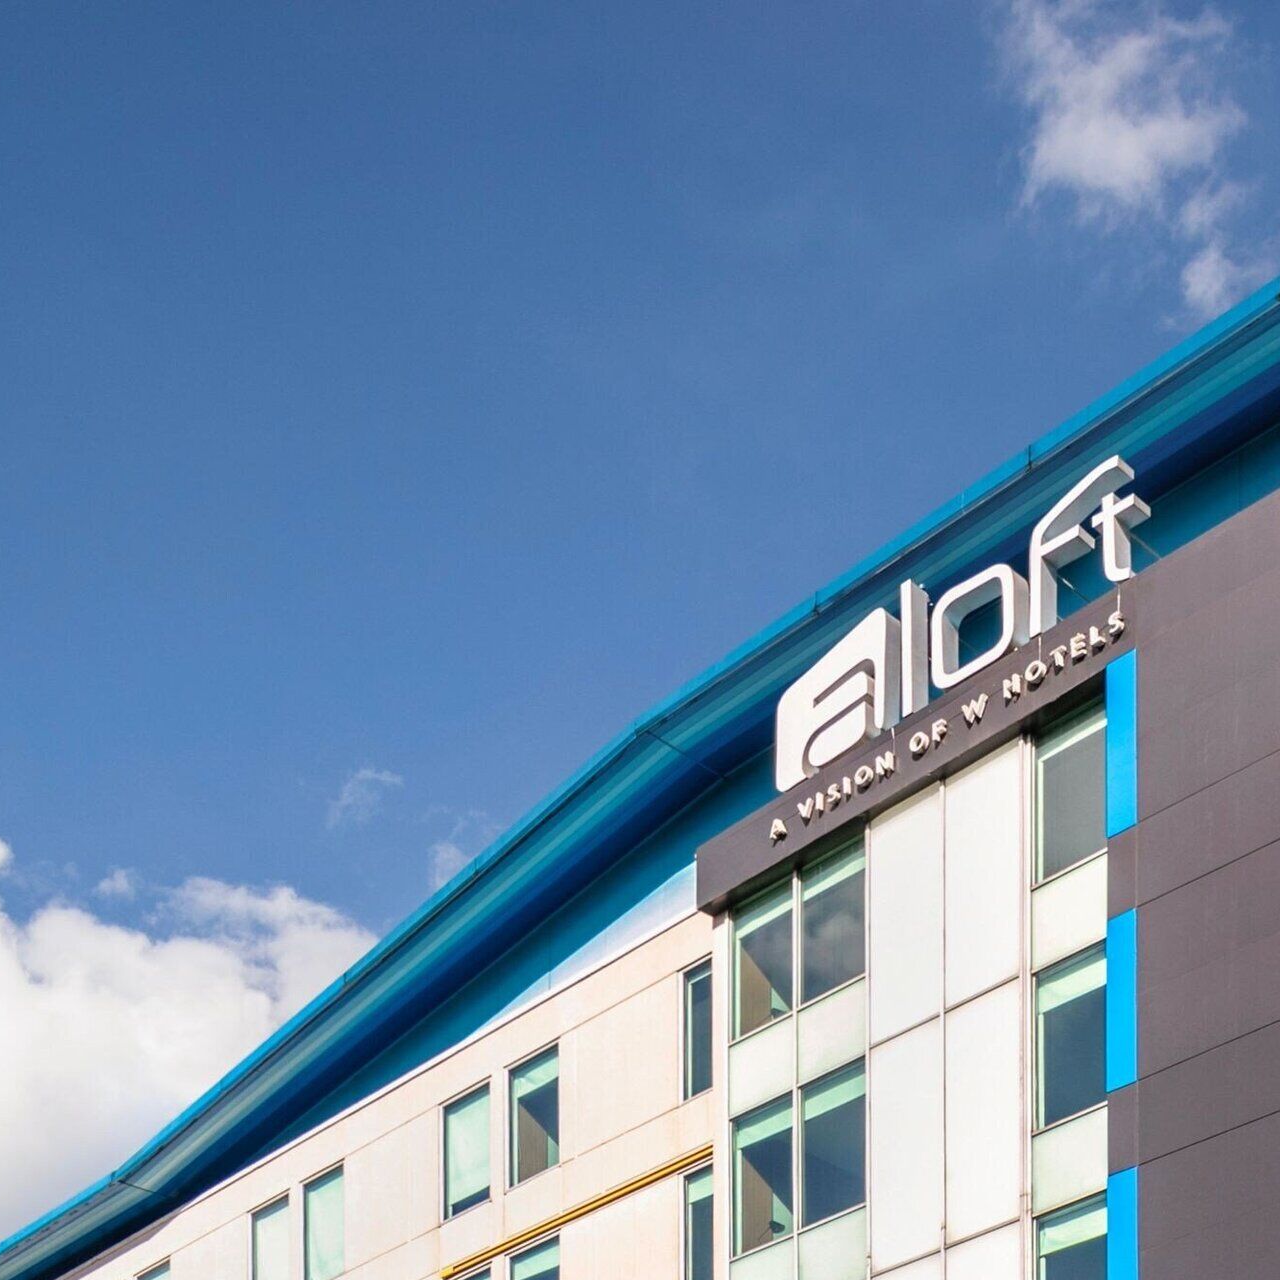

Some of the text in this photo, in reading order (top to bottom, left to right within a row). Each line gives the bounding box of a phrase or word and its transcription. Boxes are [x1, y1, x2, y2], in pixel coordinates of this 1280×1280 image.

[770, 610, 1126, 842] A VISION OF W HOTELS
[775, 454, 1151, 794] aloft
